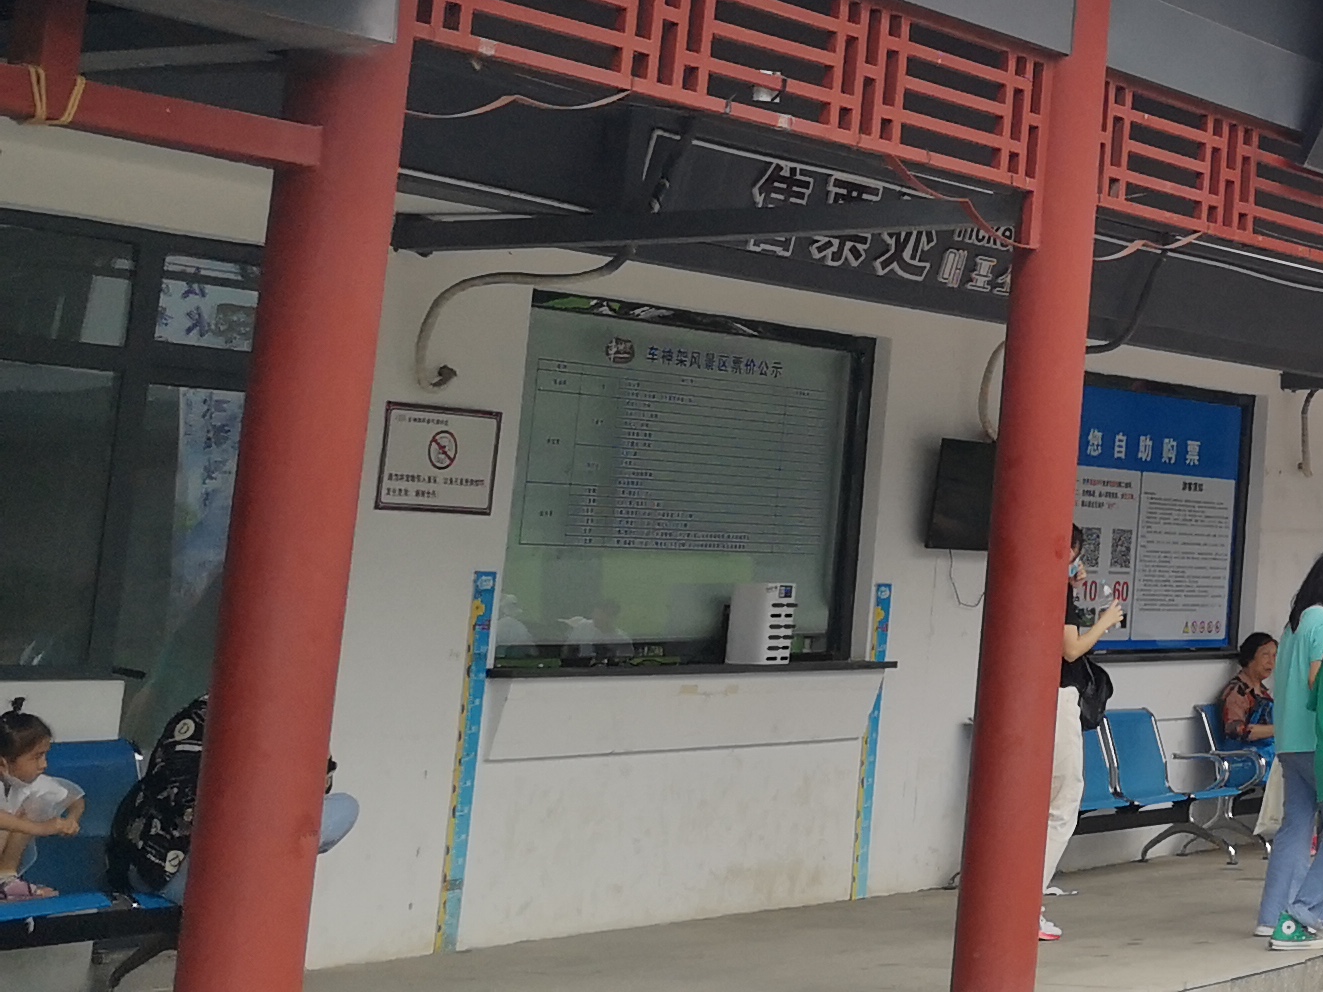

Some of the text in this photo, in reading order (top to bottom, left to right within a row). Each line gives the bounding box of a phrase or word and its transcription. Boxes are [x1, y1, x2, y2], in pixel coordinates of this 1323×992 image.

[645, 345, 784, 379] 车神架风景区票价公示
[1087, 428, 1202, 467] 您自助购票
[1082, 580, 1130, 603] 10 60
